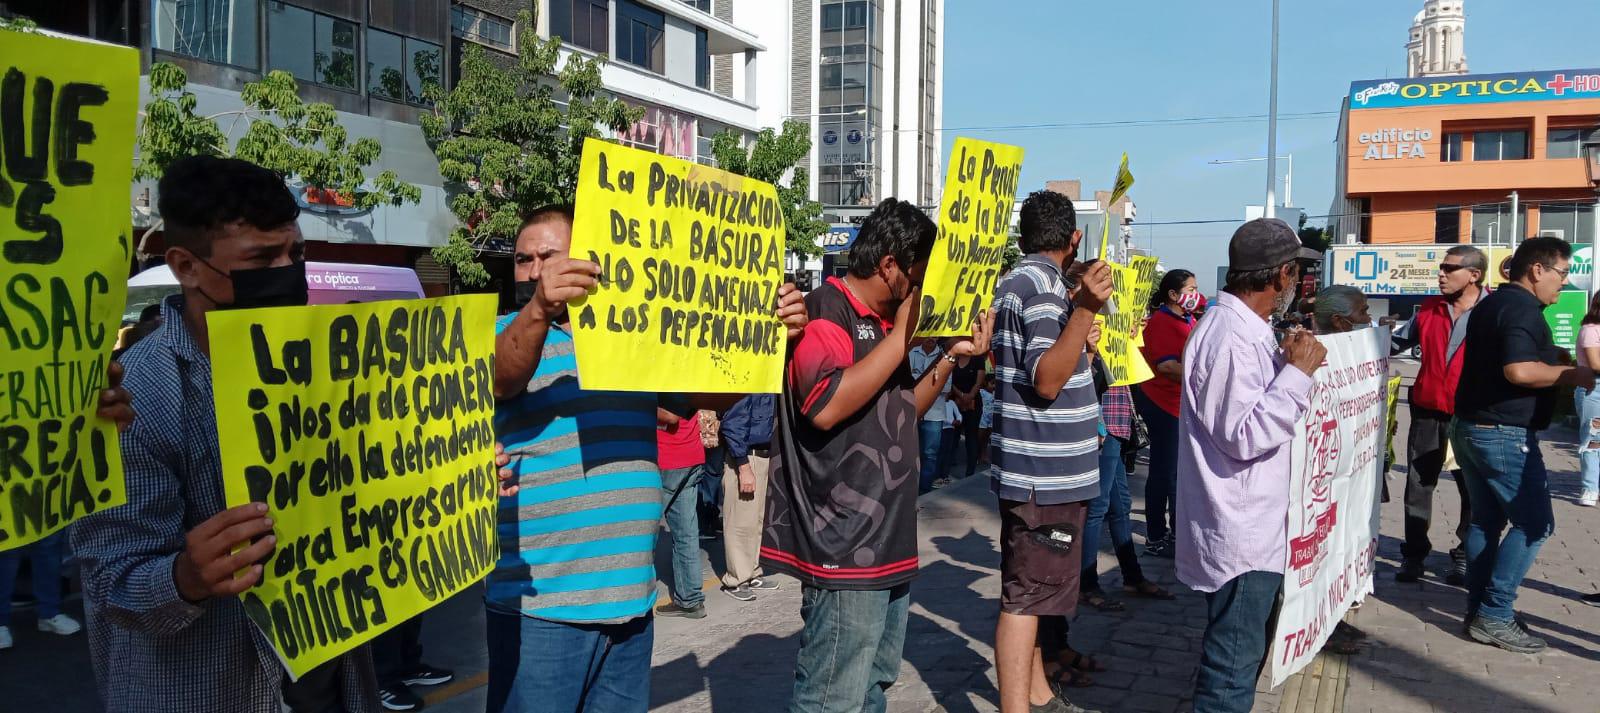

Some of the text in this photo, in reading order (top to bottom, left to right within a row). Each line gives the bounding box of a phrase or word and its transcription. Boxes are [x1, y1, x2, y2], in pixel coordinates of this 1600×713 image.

[1400, 79, 1546, 99] OPTICA
[1359, 127, 1432, 144] edificio
[1363, 142, 1426, 160] ALFA
[598, 151, 635, 194] La
[958, 146, 976, 184] La
[949, 190, 970, 223] de
[976, 200, 990, 235] la
[610, 208, 642, 249] DE
[689, 220, 780, 277] BASURA
[324, 271, 359, 288] óptica
[642, 257, 696, 303] SOLO
[1376, 283, 1396, 293] Mx
[1390, 269, 1407, 280] 24
[606, 302, 650, 334] LOS
[250, 306, 468, 386] La BASURA
[339, 380, 371, 430] da
[376, 376, 410, 421] de
[309, 440, 353, 496] ello
[358, 429, 388, 484] la
[340, 462, 496, 553] Empresarios
[378, 537, 408, 590] es
[409, 504, 499, 602] GANANCI
